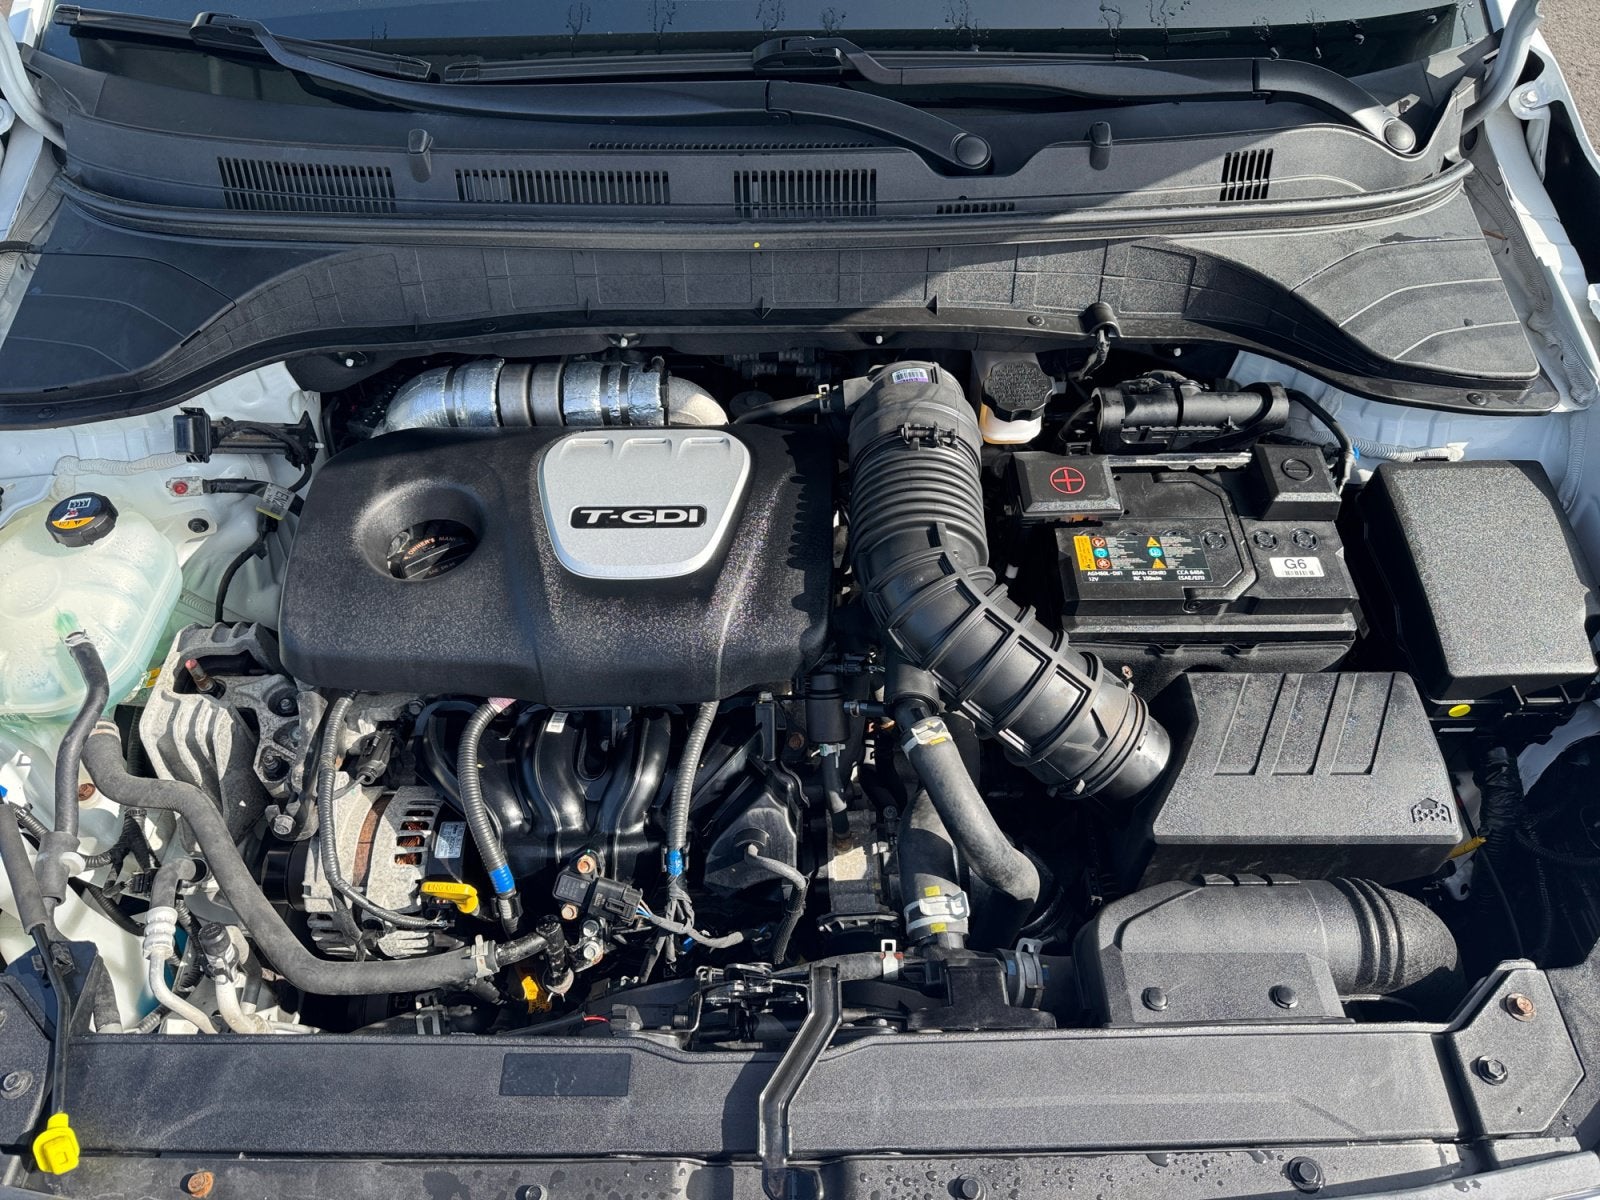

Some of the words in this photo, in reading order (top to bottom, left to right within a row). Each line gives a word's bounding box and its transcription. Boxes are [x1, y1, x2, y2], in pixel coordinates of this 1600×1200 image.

[580, 509, 698, 524] T-GDI
[1284, 558, 1307, 569] G6
[427, 883, 444, 892] ENG
